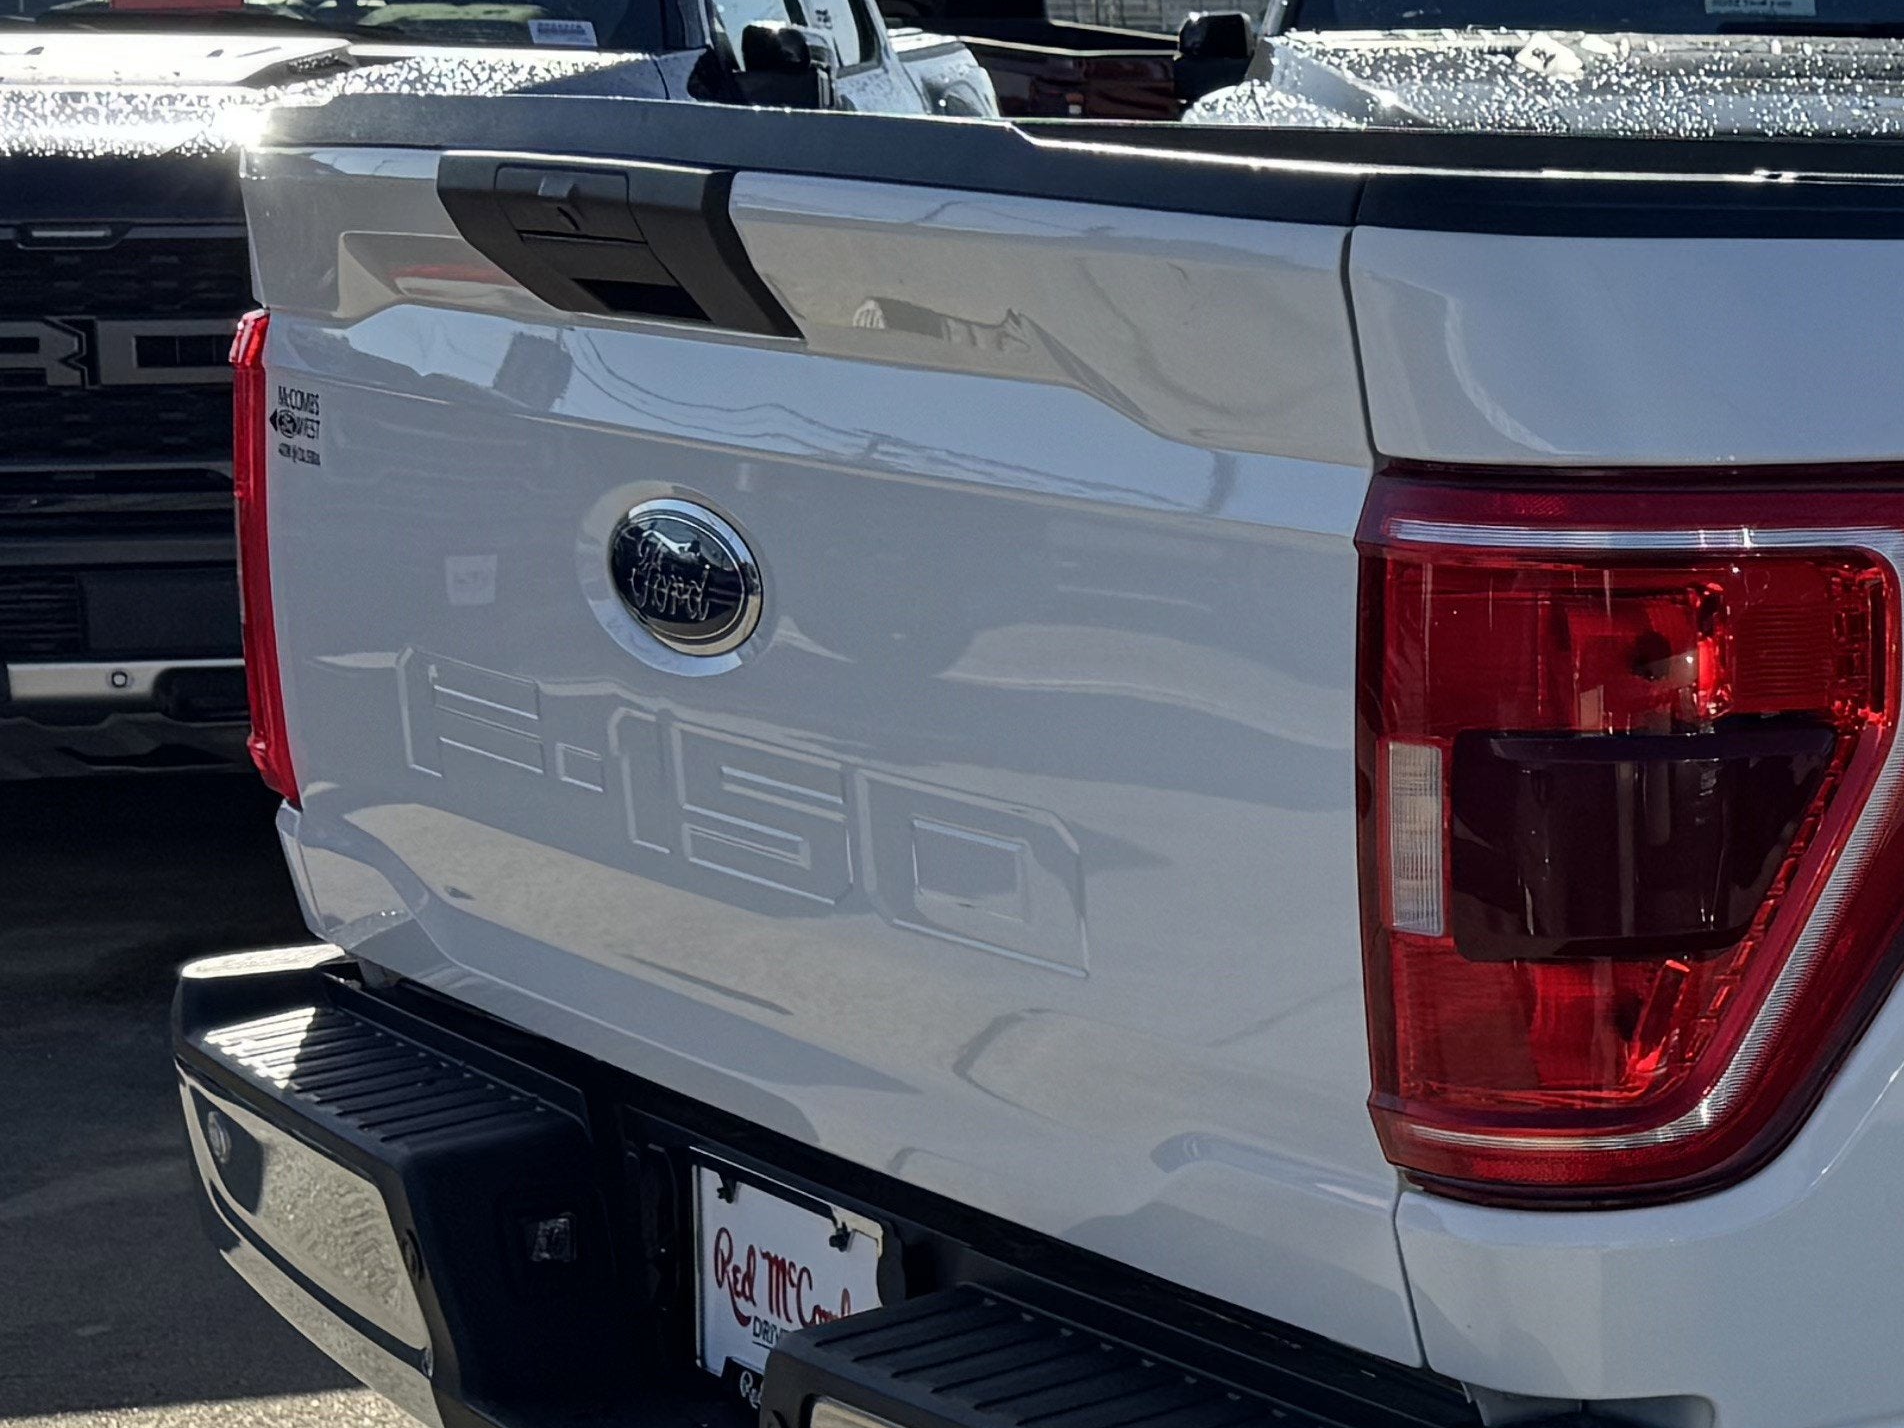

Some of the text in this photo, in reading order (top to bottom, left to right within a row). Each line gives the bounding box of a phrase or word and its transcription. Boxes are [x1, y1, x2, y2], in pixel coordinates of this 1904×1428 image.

[628, 536, 711, 622] Ford
[714, 1226, 853, 1329] Red McComb
